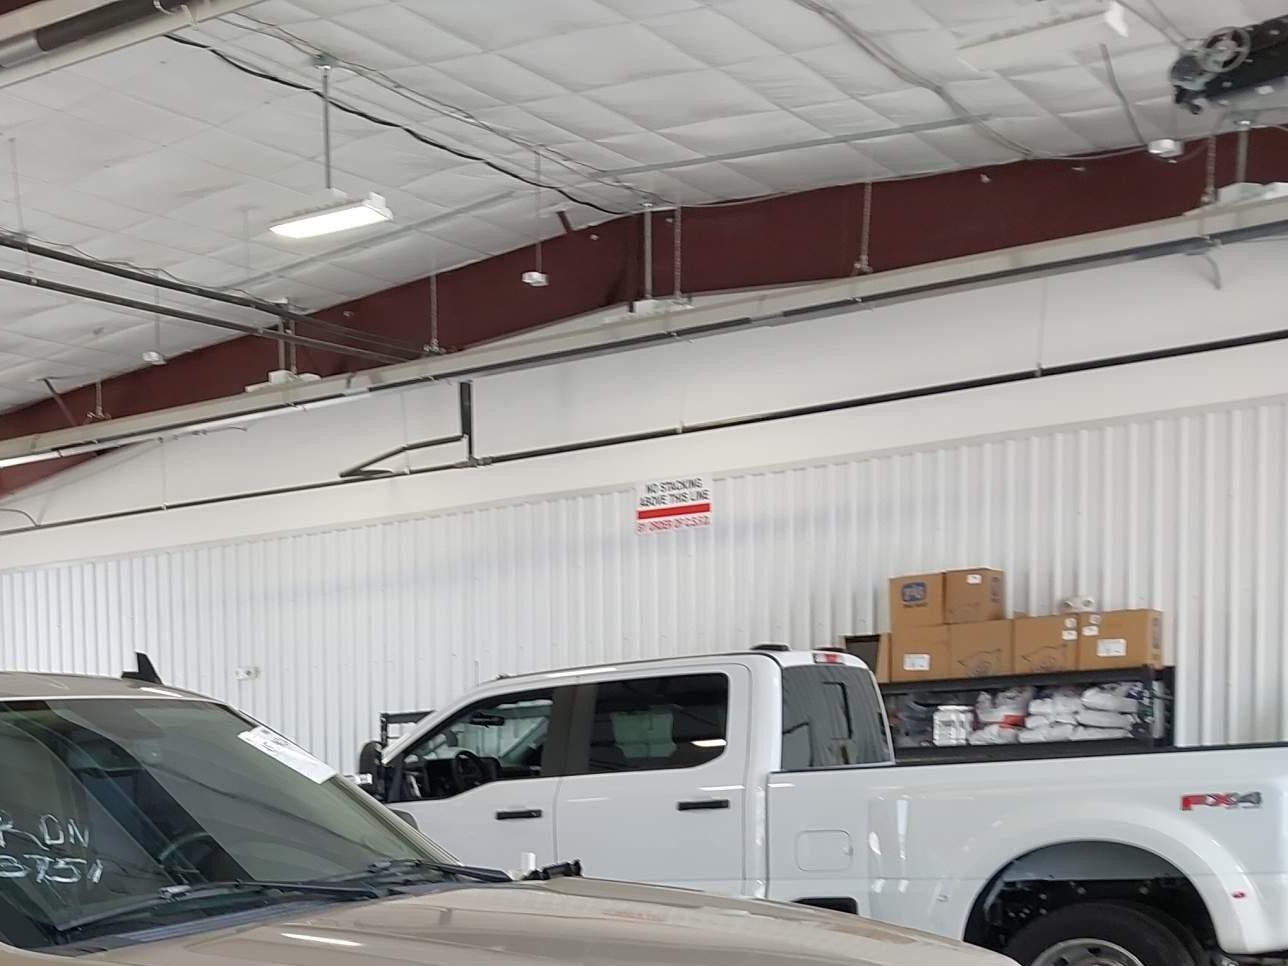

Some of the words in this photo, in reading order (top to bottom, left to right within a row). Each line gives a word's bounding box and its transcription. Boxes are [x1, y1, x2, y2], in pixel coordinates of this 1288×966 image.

[646, 483, 658, 494] NO
[660, 477, 702, 492] STACKING
[639, 494, 667, 507] ABOVE
[669, 491, 689, 504] THIS
[690, 488, 710, 501] LINE
[1181, 791, 1261, 811] FX4
